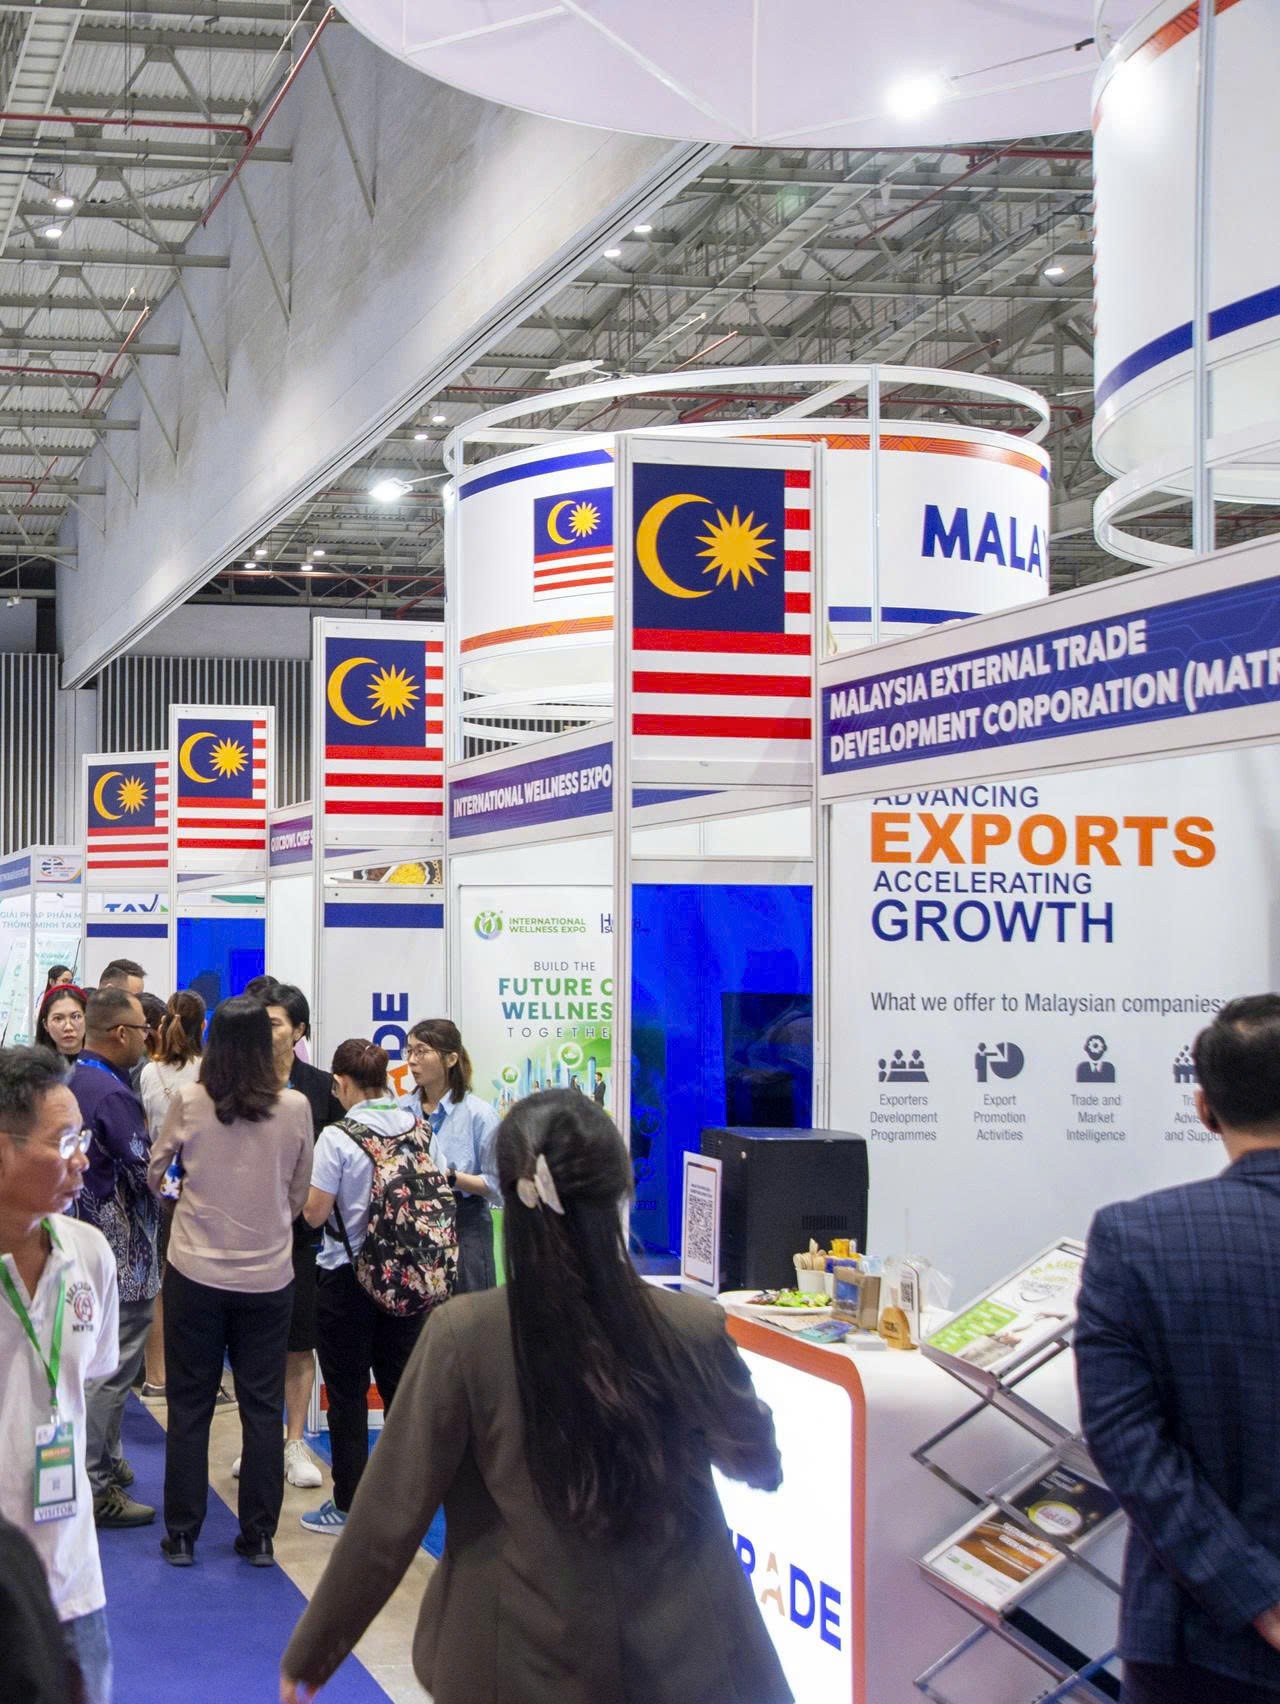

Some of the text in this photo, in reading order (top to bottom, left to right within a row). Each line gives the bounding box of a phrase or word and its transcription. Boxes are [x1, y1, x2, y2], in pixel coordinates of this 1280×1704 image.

[921, 504, 1048, 577] MALA
[829, 619, 1148, 720] MALAYSIA EXTERNAL TRADE
[830, 707, 982, 763] DEVELOPMENT
[982, 672, 1179, 736] CORPORATION
[453, 763, 613, 818] INTERNATIONAL WELLNESS EXPO
[870, 811, 1217, 869] EXPORTS
[873, 870, 1093, 895] ACCELERATING
[509, 917, 586, 926] INTERNATIONAL
[871, 898, 1114, 943] GROWTH
[509, 925, 587, 934] WELLNESS EXPO
[534, 961, 596, 972] BUILD THE
[498, 977, 593, 996] FUTURE
[501, 1001, 613, 1020] WELLNES
[871, 991, 916, 1012] What
[921, 998, 947, 1012] we
[953, 992, 996, 1012] offer
[1001, 994, 1019, 1012] to
[1025, 992, 1116, 1017] Malaysian
[507, 1027, 610, 1039] TOGETHE
[879, 1094, 928, 1110] Exporters
[983, 1094, 1017, 1109] Export
[1070, 1094, 1121, 1106] Trade and
[870, 1111, 938, 1127] Development
[973, 1111, 1026, 1124] Promotion
[1077, 1111, 1114, 1124] Market
[870, 1128, 937, 1144] Programmes
[976, 1128, 1024, 1141] Activities
[1066, 1128, 1126, 1145] Intelligence
[1164, 1130, 1185, 1141] and
[38, 1504, 74, 1520] VISITOR
